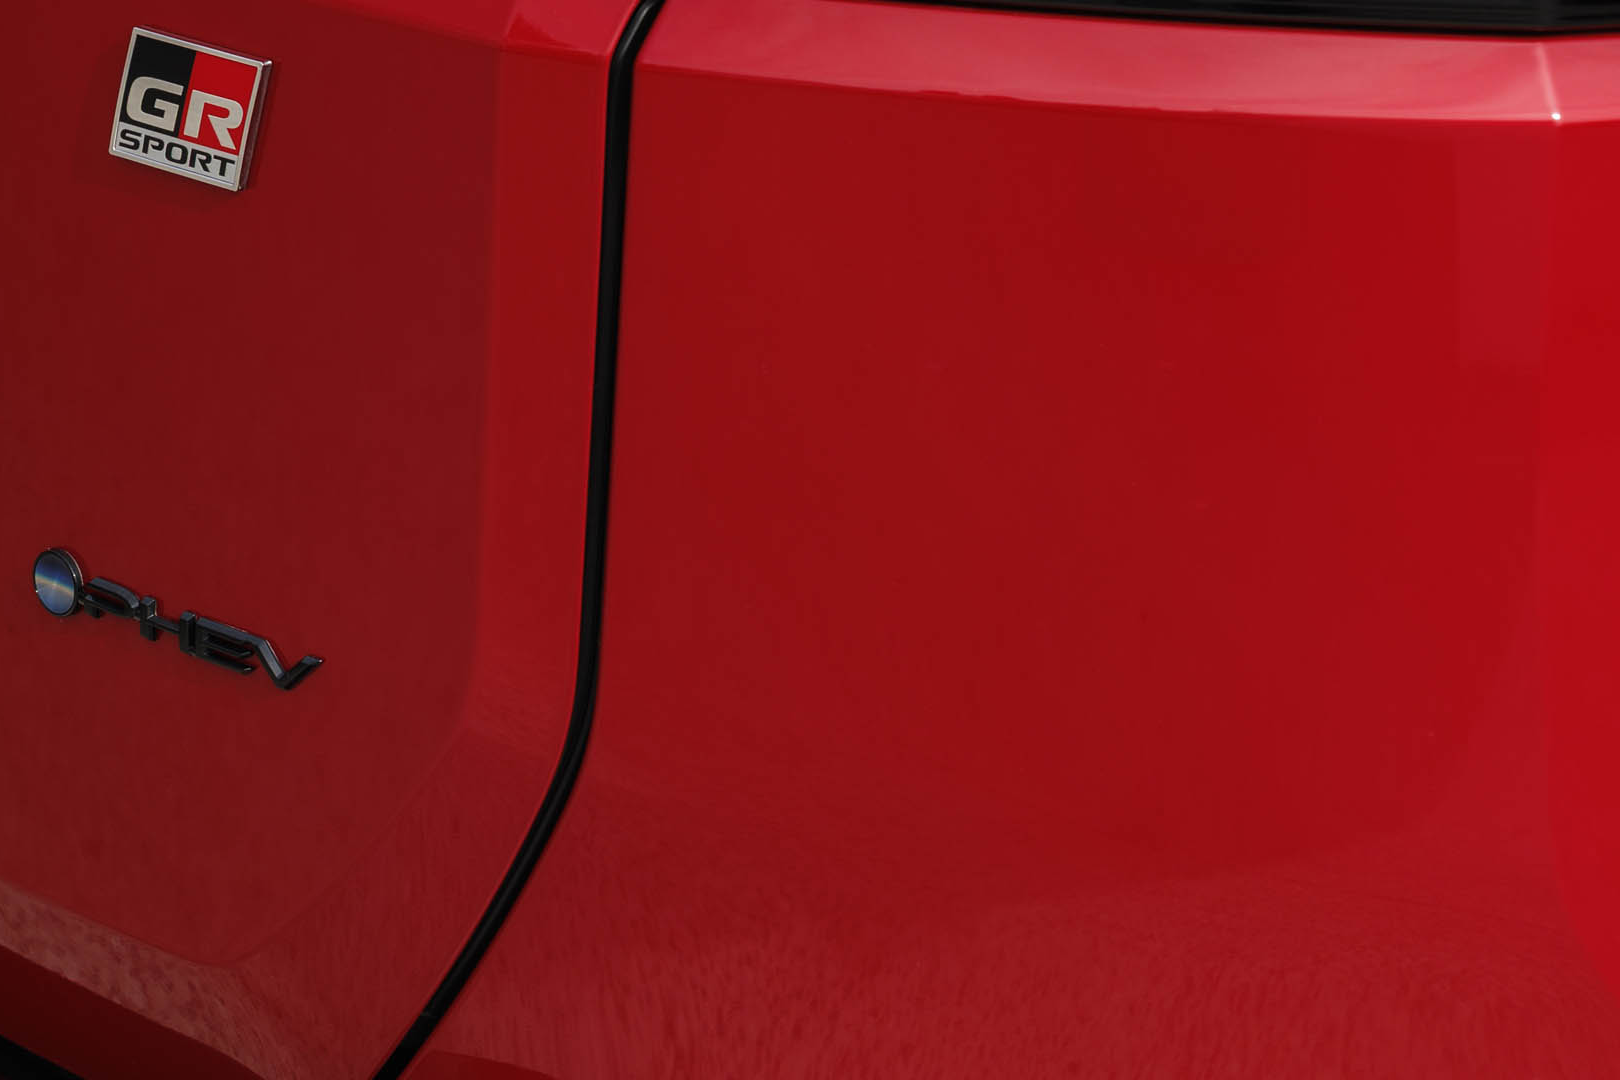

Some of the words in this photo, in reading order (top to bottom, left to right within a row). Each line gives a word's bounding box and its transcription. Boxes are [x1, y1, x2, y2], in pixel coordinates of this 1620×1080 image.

[126, 75, 244, 151] GR
[118, 128, 236, 177] SPORT
[80, 576, 324, 691] PHEV
